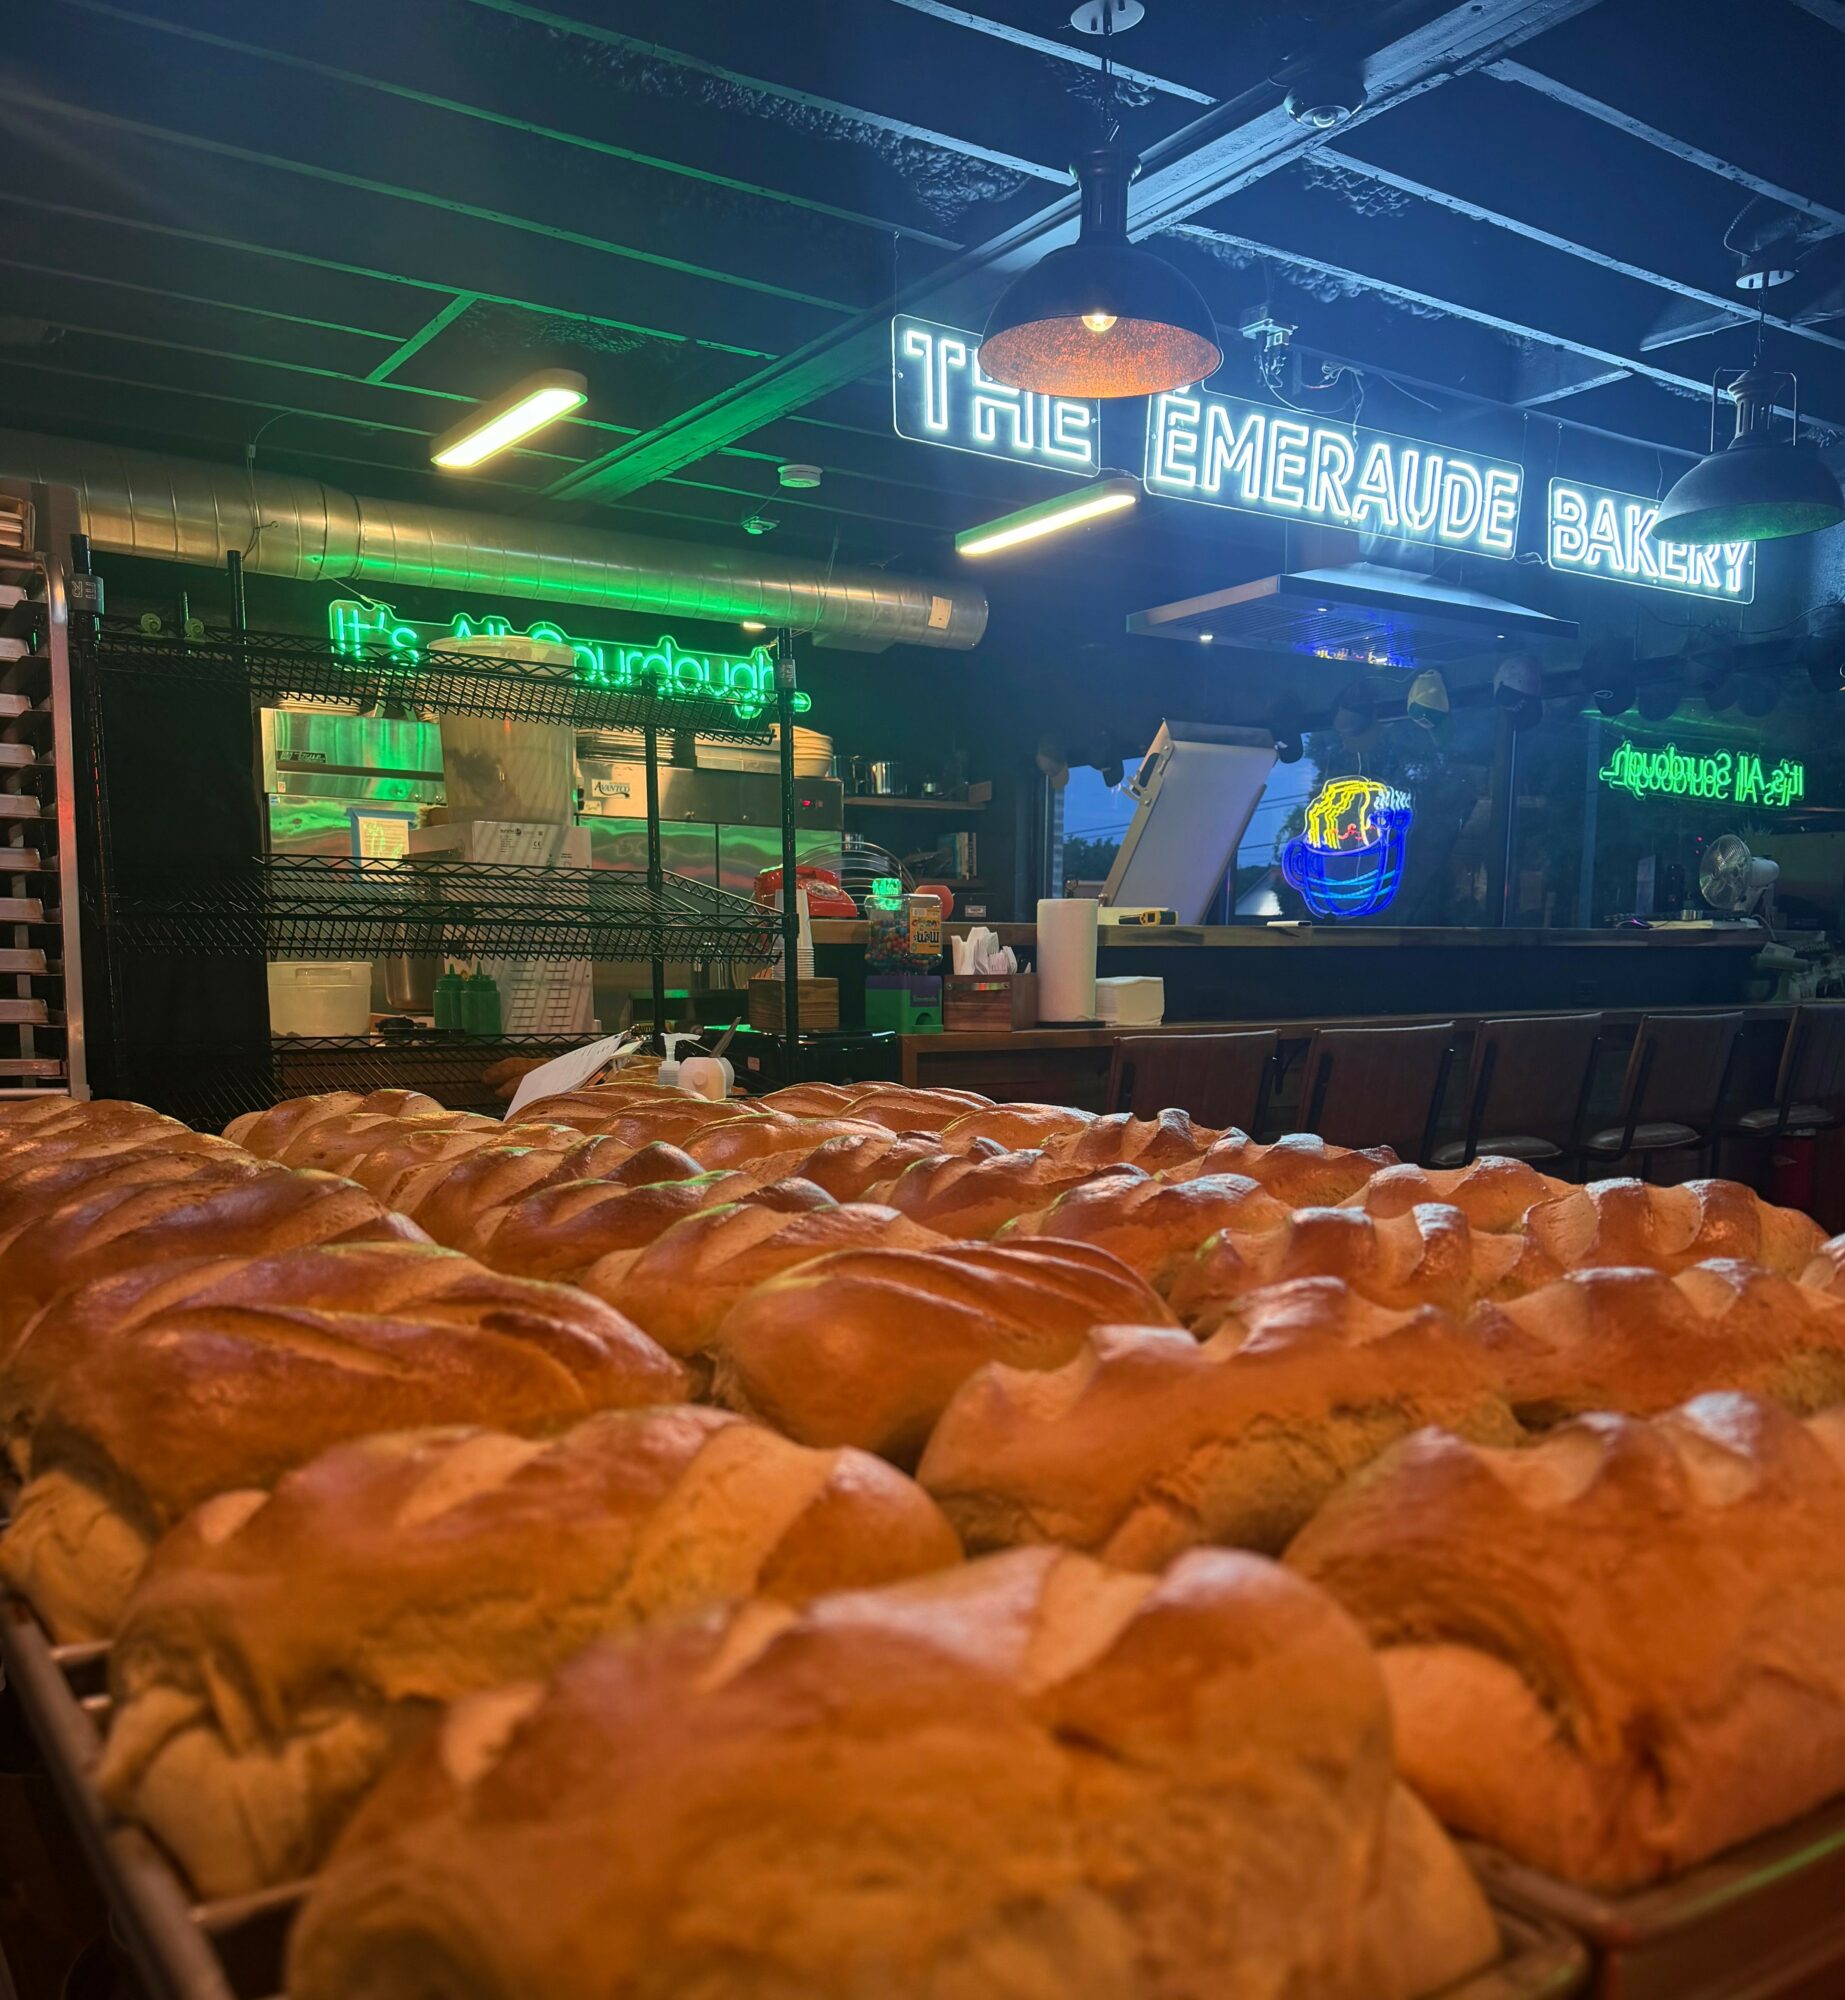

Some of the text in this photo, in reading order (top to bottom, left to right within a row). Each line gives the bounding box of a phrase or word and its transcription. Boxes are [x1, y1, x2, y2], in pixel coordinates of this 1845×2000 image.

[904, 330, 1092, 462] THE
[1553, 488, 1750, 593] BAKERY
[336, 607, 420, 663] It's
